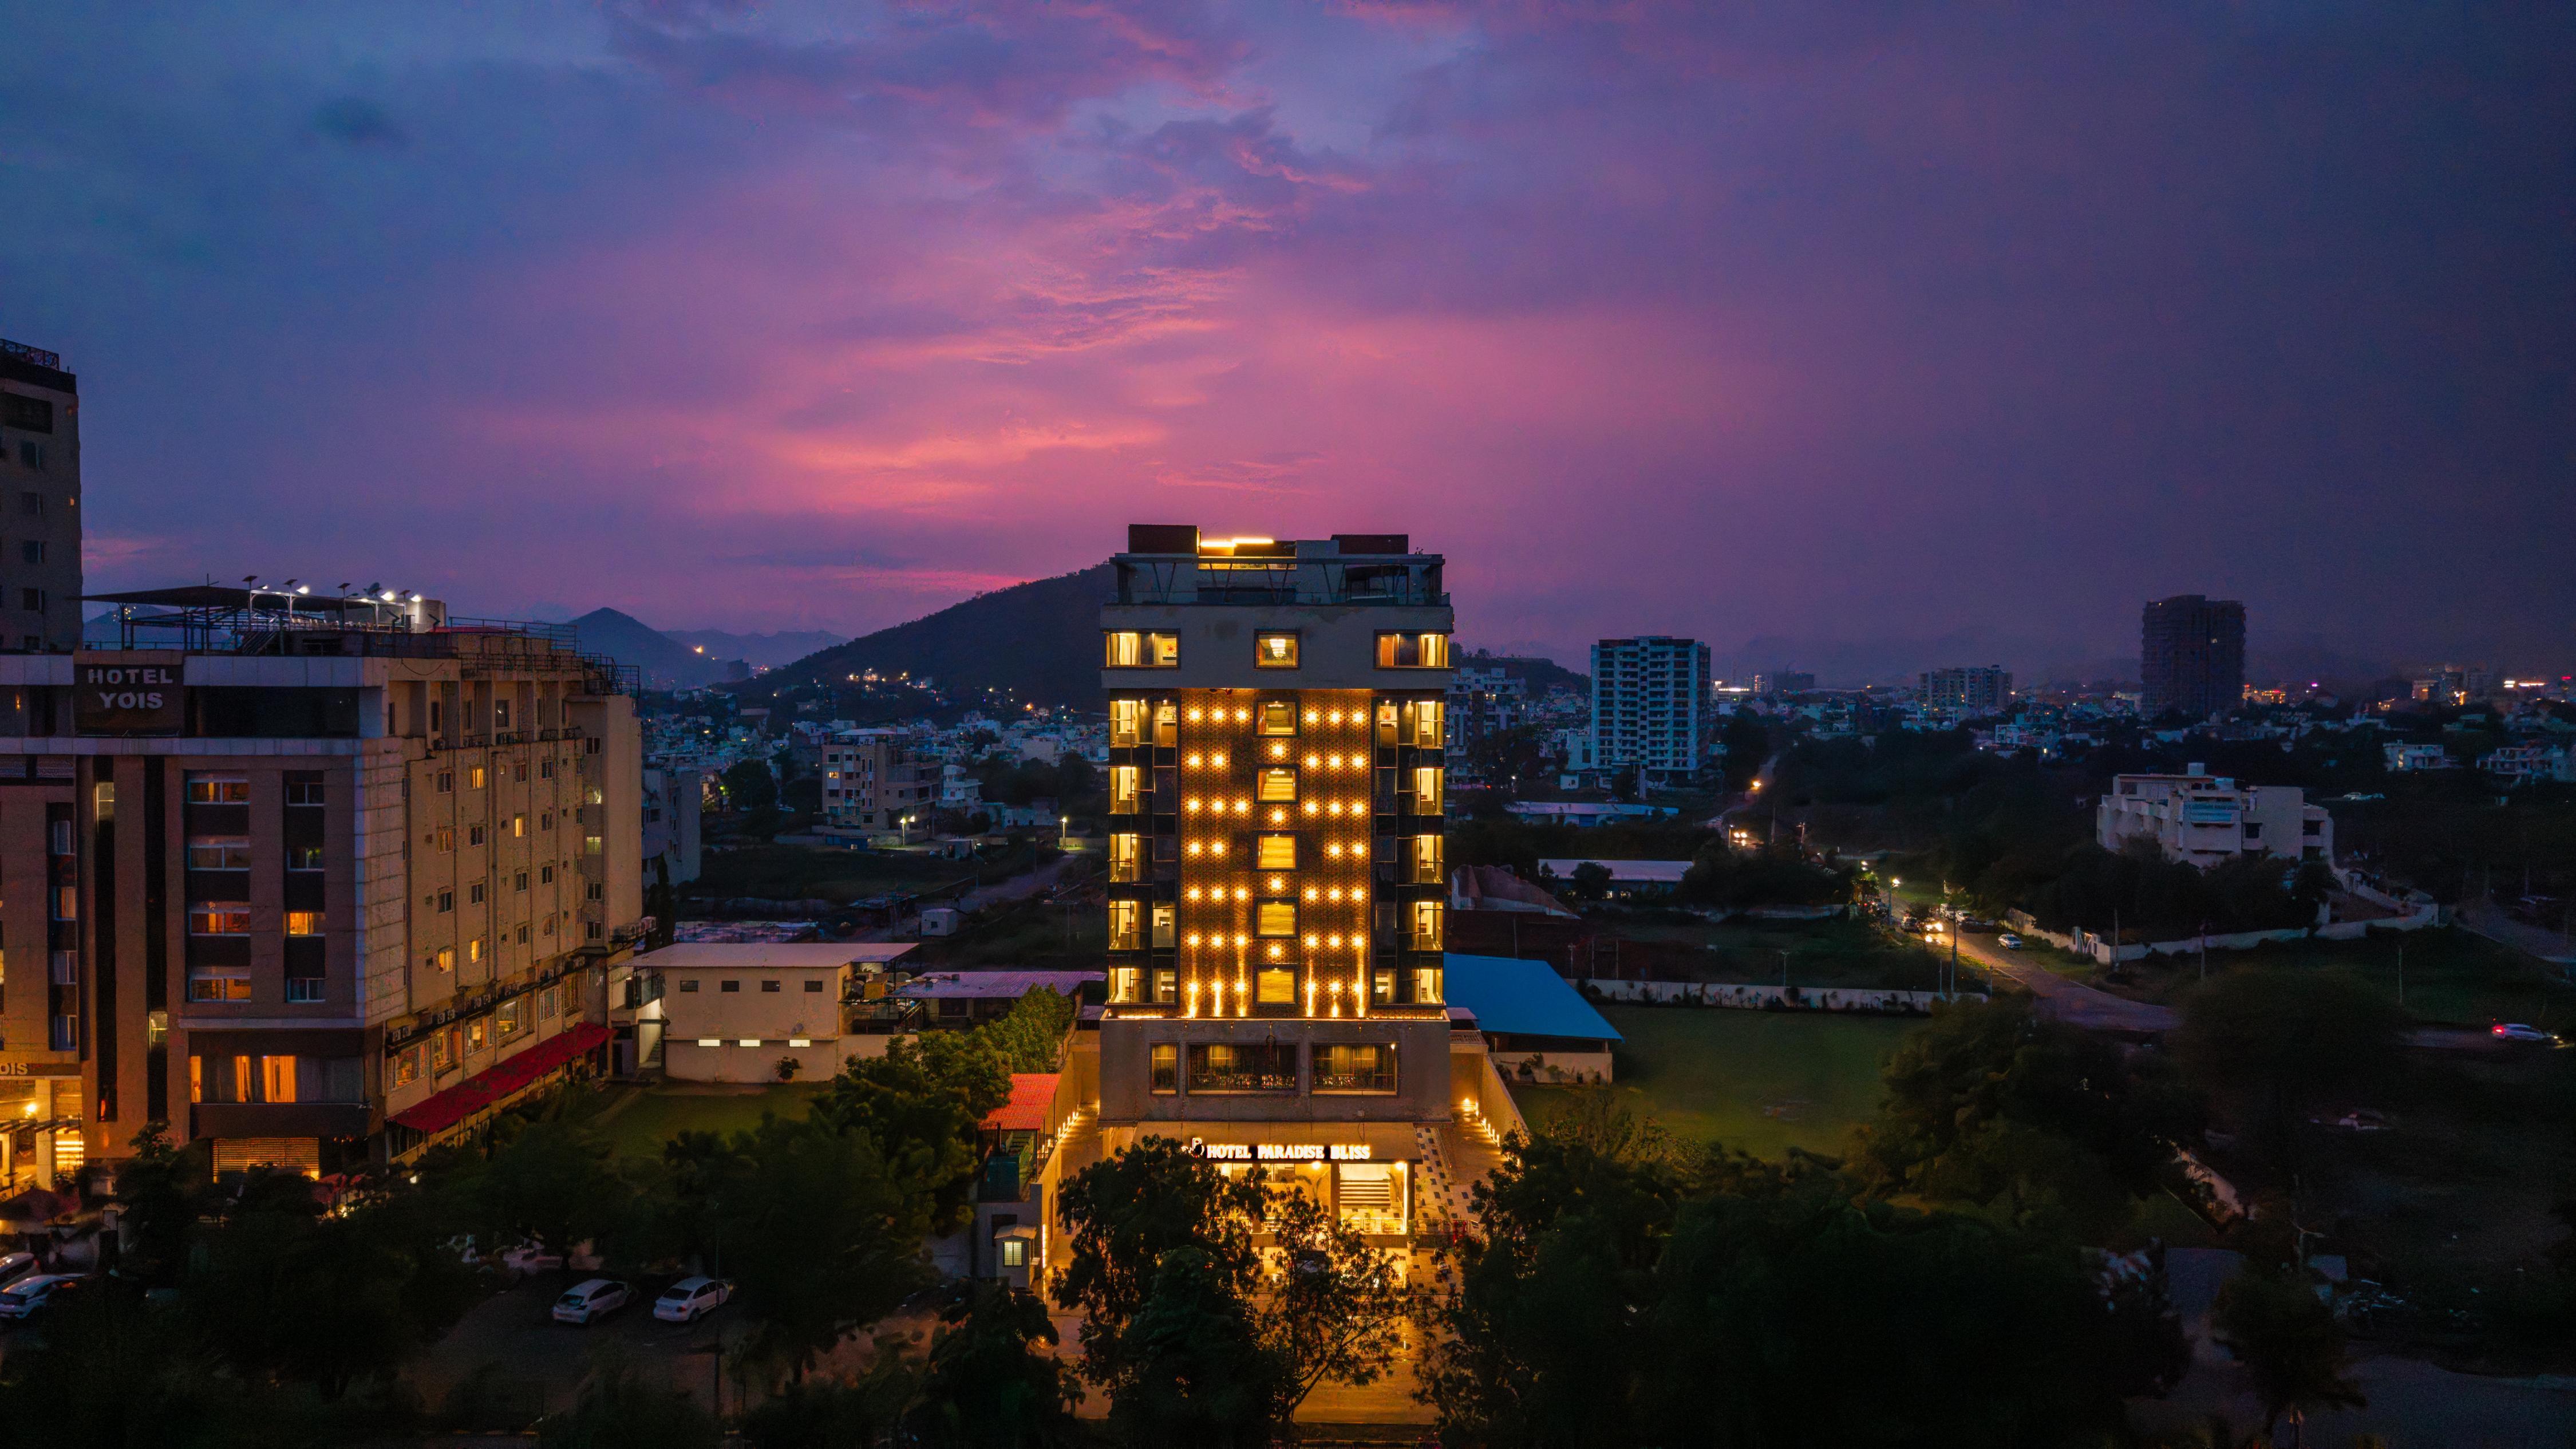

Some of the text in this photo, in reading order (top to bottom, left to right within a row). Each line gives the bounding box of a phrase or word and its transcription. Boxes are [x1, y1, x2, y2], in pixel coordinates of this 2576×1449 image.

[88, 669, 173, 684] HOTEL
[99, 692, 163, 709] YOIS
[1207, 1144, 1370, 1159] HOTEL PARADISE BLISS
